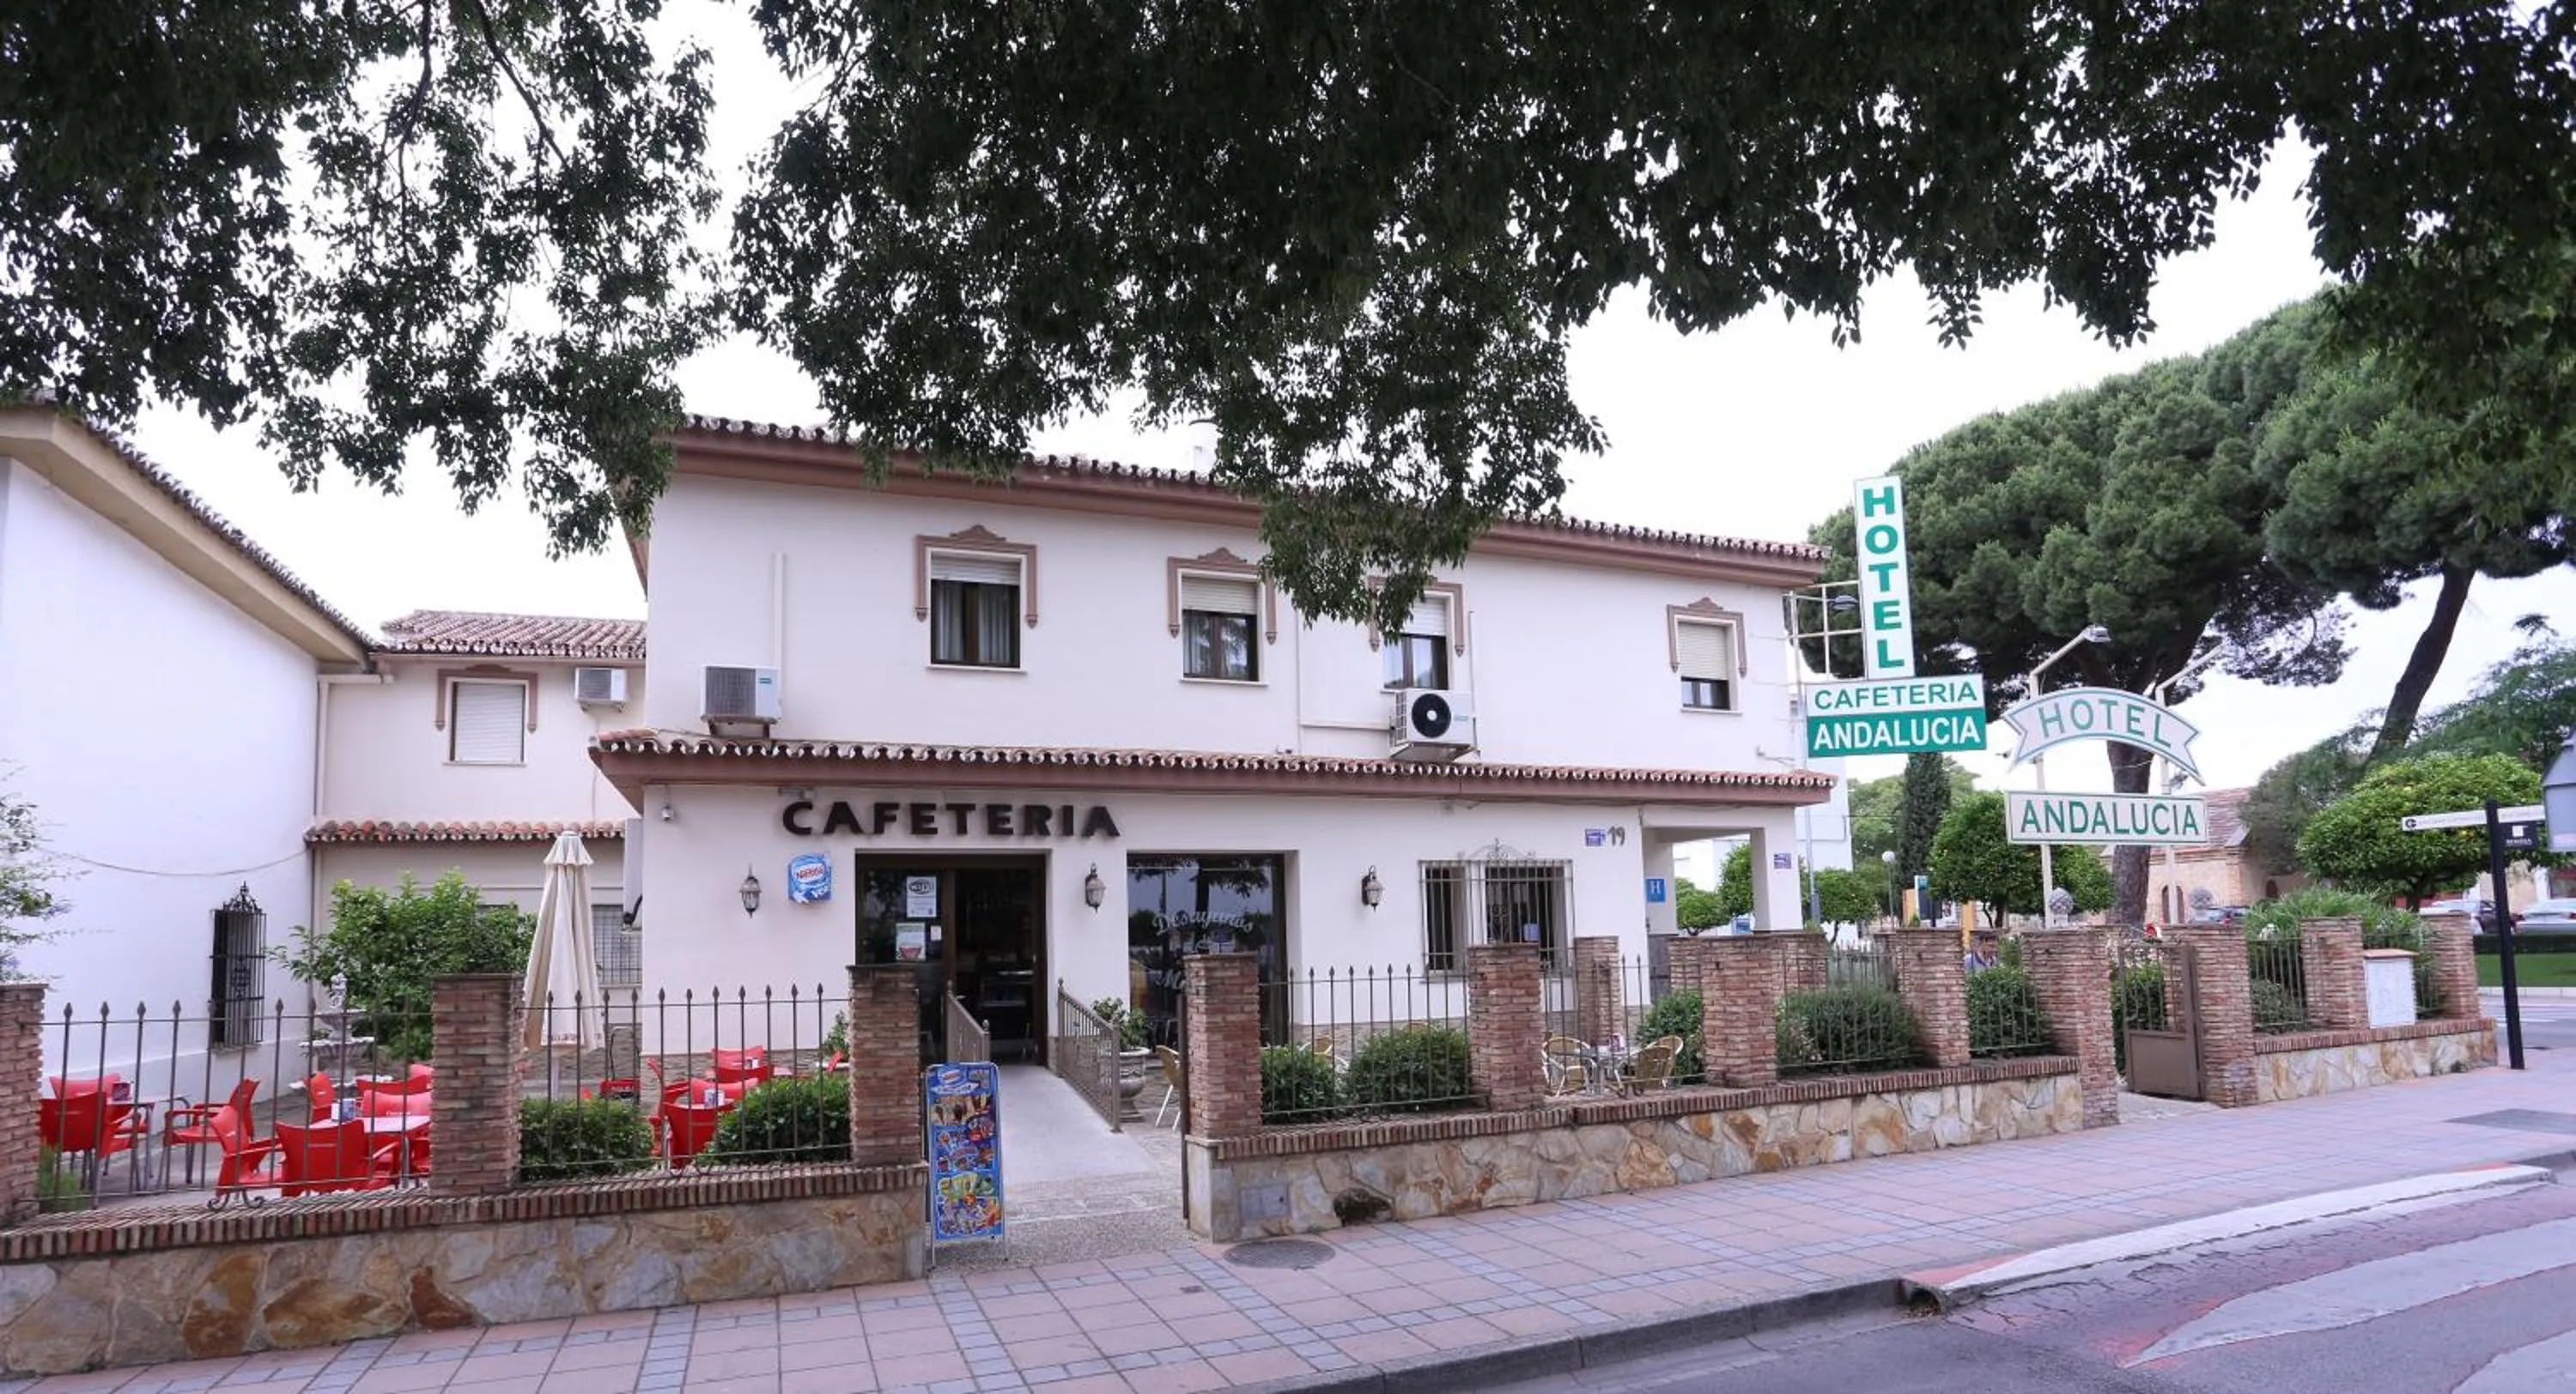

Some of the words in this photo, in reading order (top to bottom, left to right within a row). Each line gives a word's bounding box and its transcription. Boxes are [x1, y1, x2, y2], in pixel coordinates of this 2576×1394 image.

[1862, 486, 1904, 669] HOTEL
[1814, 682, 1978, 710] CAFETERIA
[1814, 718, 1981, 750] ANDALUCIA
[2038, 698, 2172, 749] HOTEL
[782, 801, 1121, 836] CAFETERIA
[2020, 798, 2199, 836] ANDALUCIA
[1607, 826, 1625, 846] 19
[1649, 881, 1661, 894] H
